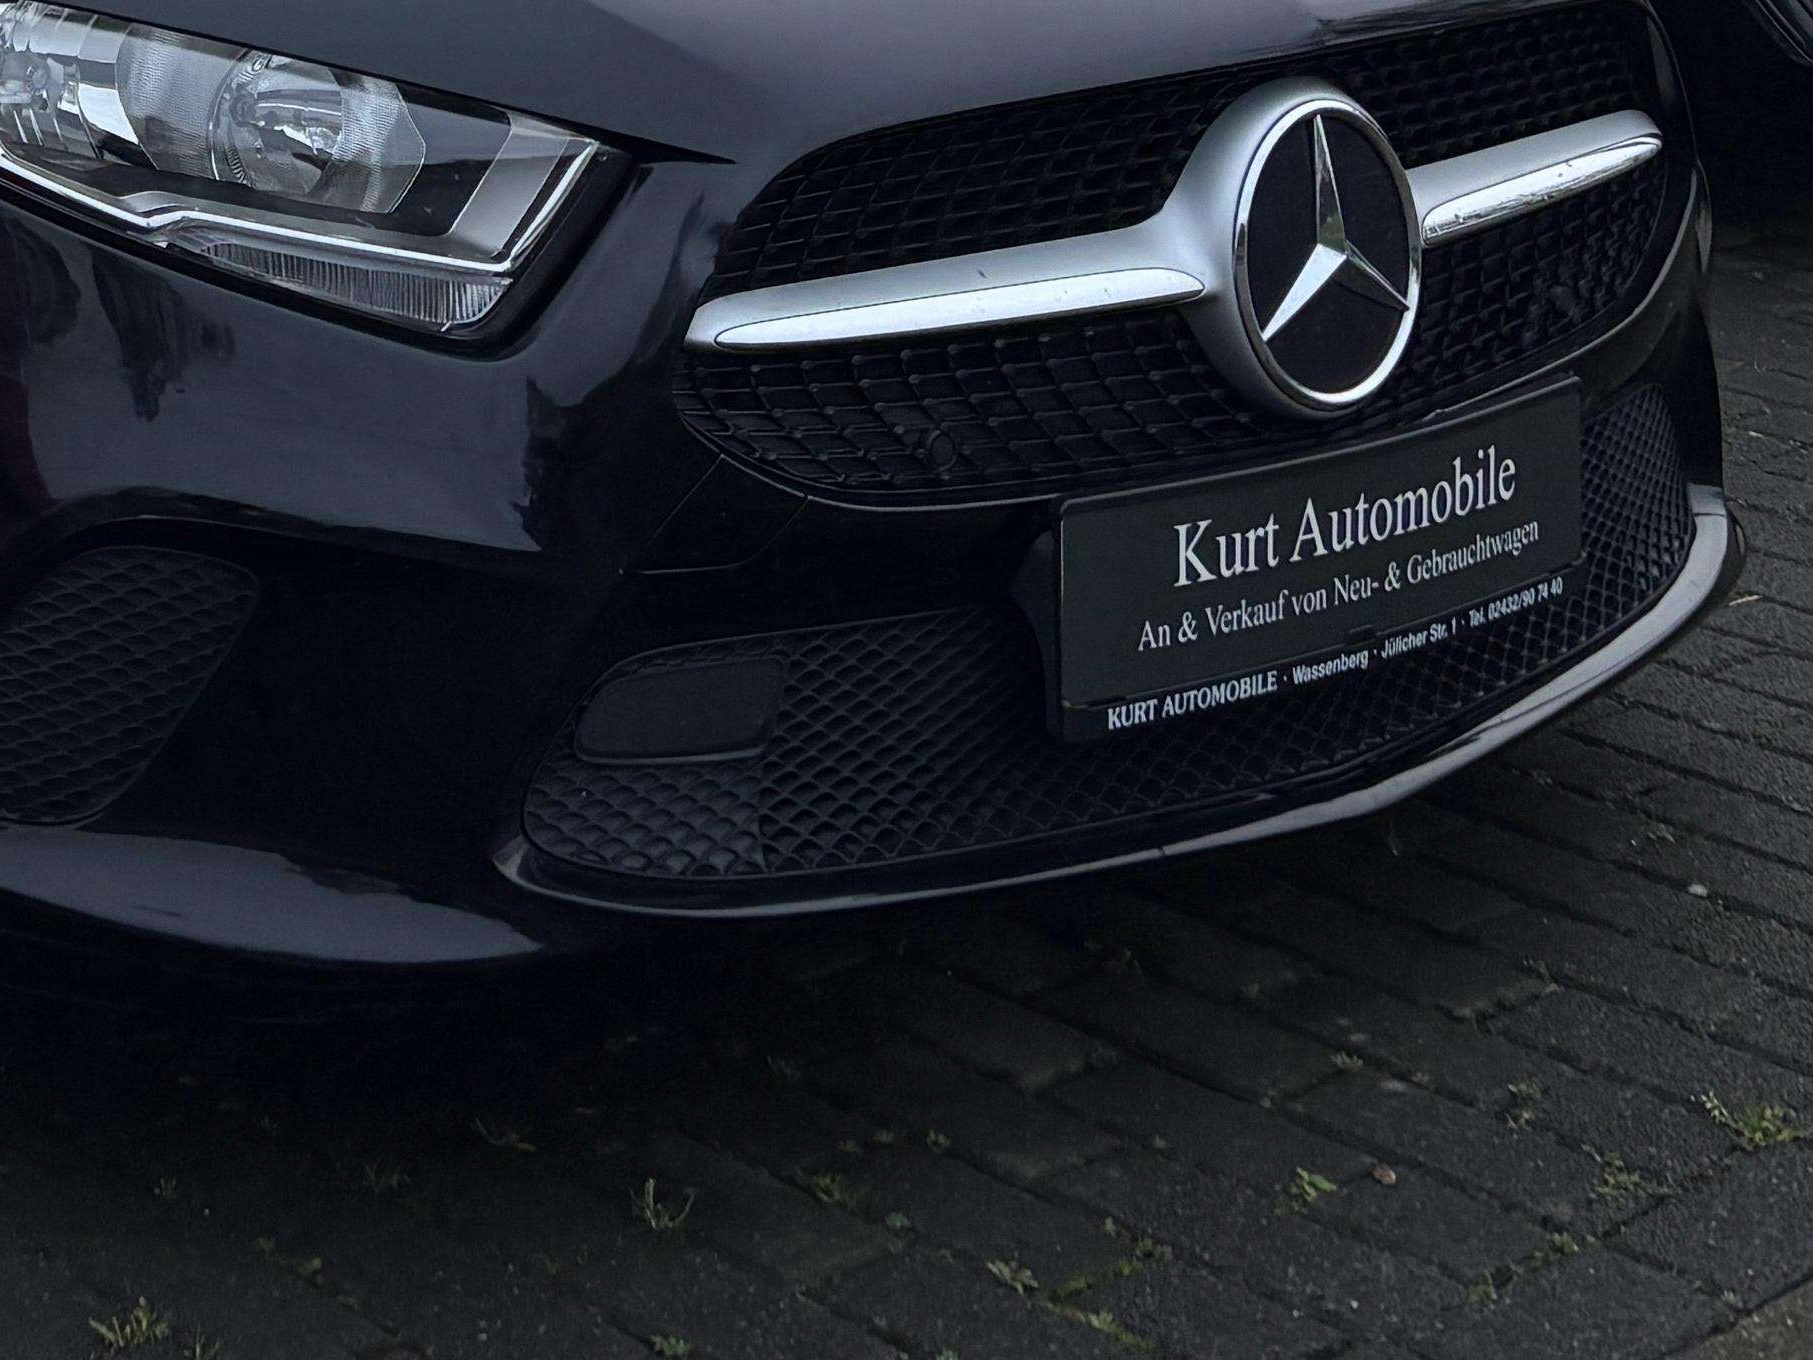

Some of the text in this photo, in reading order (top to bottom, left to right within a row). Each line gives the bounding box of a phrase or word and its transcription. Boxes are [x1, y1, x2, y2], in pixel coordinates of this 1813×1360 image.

[1138, 520, 1540, 652] An & Verkauf von Neu- & Gebrauchtwagen
[1173, 444, 1516, 588] Kurt Automobile
[1107, 698, 1158, 730] KURT
[1161, 669, 1279, 719] AUTOMOBILE
[1292, 649, 1369, 686] Wassenberg
[1381, 630, 1428, 659] Jülicher
[1429, 623, 1448, 643] Str.
[1451, 616, 1457, 634] 1
[1468, 606, 1486, 628] Tel.
[1550, 575, 1564, 596] 40
